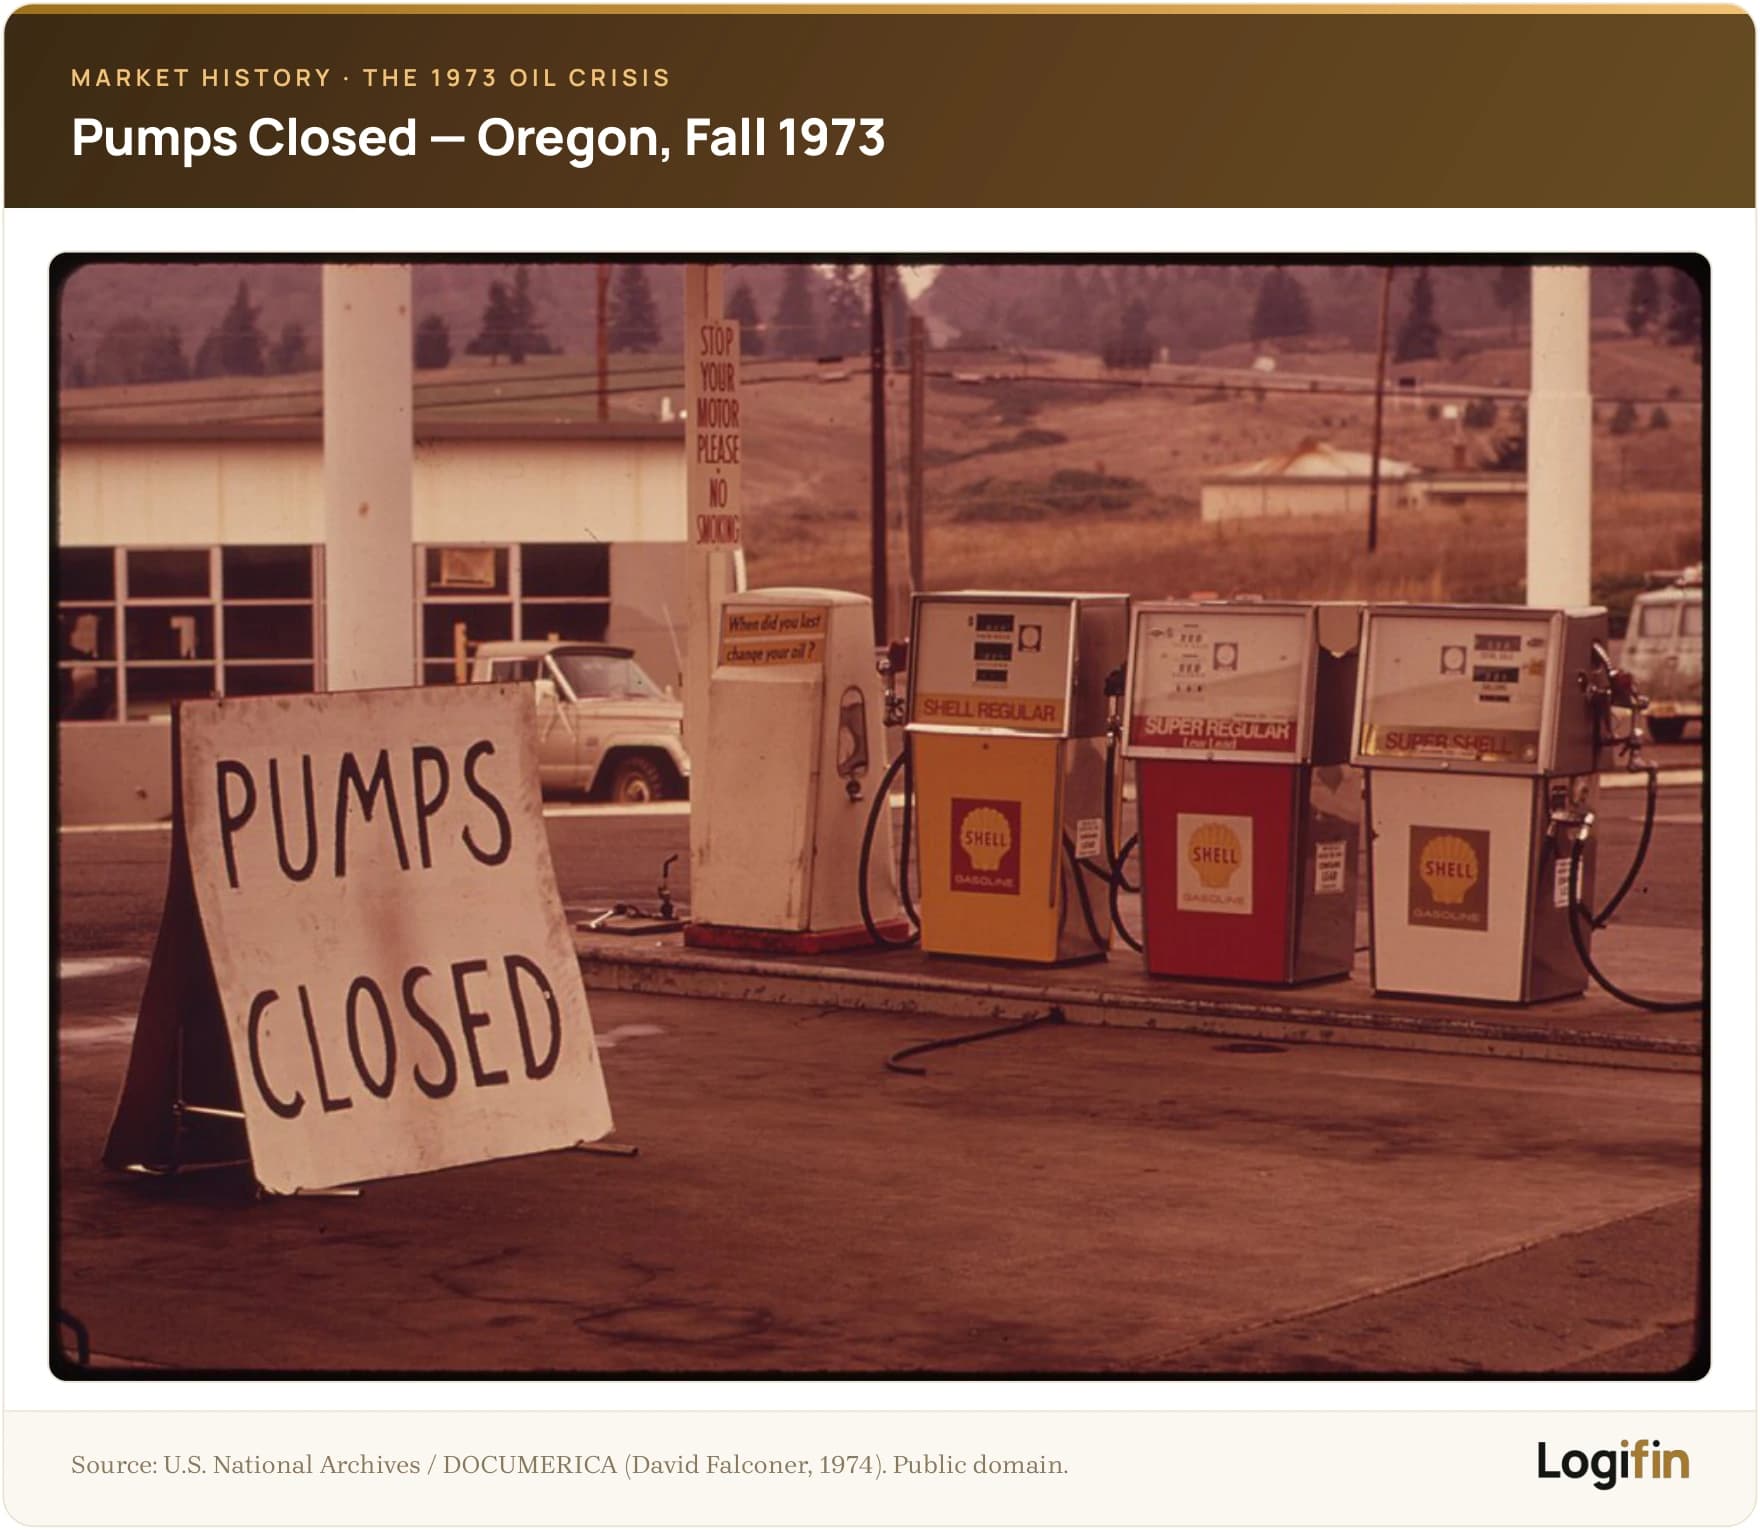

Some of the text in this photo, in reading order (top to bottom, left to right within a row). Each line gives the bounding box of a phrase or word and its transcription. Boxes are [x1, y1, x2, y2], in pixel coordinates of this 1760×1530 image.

[701, 326, 733, 355] STOP
[701, 363, 735, 392] YOUR
[697, 398, 739, 428] MOTOR
[697, 434, 739, 464] PLEASE
[709, 479, 728, 508] NO
[697, 514, 739, 544] SMOKING
[729, 612, 821, 632] When did you last
[727, 646, 763, 663] change
[765, 649, 791, 662] your
[792, 643, 805, 659] oil
[923, 698, 1056, 722] SHELL REGULAR
[1145, 717, 1290, 740] SUPER REGULAR
[1183, 737, 1207, 749] Low
[1385, 731, 1513, 755] SUPER SHELL
[216, 740, 512, 889] PUMPS
[965, 831, 1007, 847] SHELL
[1193, 847, 1238, 864] SHELL
[954, 874, 1016, 888] GASOLINE
[1425, 860, 1473, 879] SHELL
[1413, 908, 1481, 922] GASOLINE
[247, 954, 562, 1120] CLOSED
